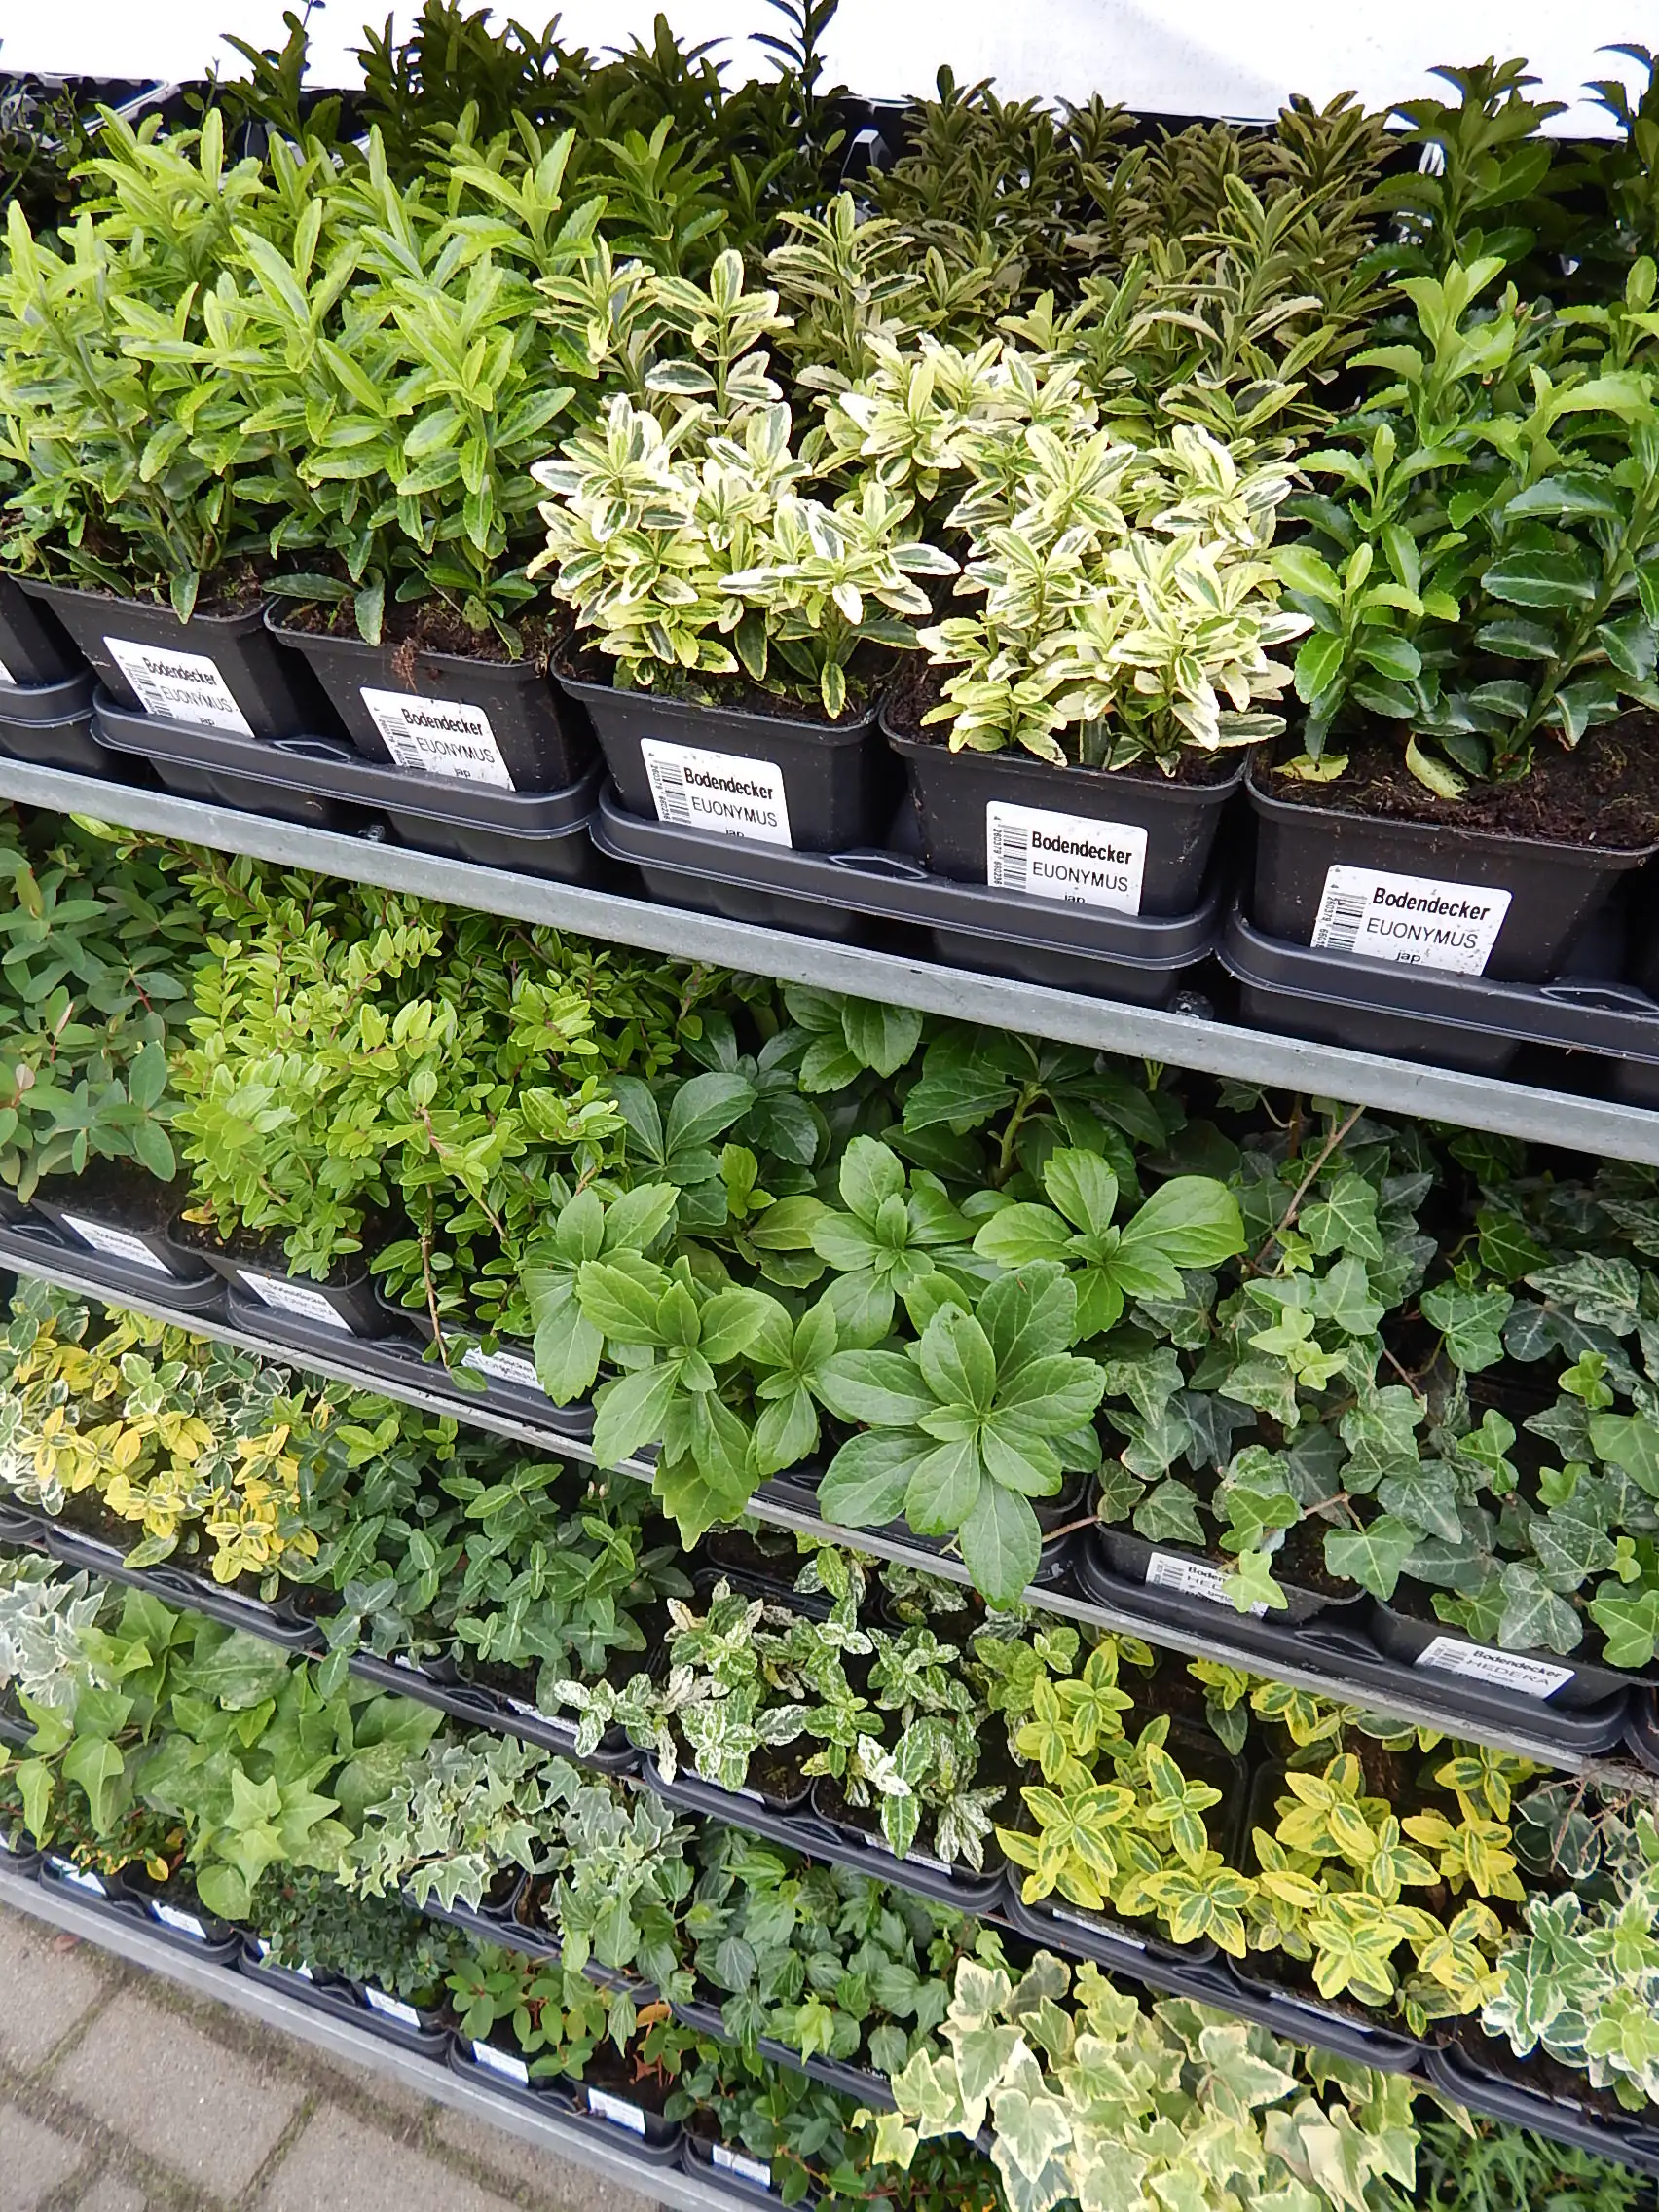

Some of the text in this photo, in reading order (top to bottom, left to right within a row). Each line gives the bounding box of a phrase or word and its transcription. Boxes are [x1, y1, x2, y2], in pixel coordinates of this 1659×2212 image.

[142, 656, 217, 685] Bodendecker
[161, 685, 233, 713] EUONYMUS
[401, 708, 484, 736] Bodendecker
[415, 736, 496, 763] EUONYMUS
[683, 766, 773, 799] Bodendecker
[691, 795, 778, 828] EUONYMUS
[1032, 830, 1133, 865] Bodendecker
[1032, 861, 1128, 893] EUONYMUS
[1372, 887, 1491, 921] Bodendecker
[1366, 917, 1478, 949] EUONYMUS
[1395, 950, 1421, 963] jap
[1188, 1566, 1227, 1583] Boden
[1466, 1659, 1549, 1686] HEDERA
[1473, 1650, 1562, 1677] Bodendecker
